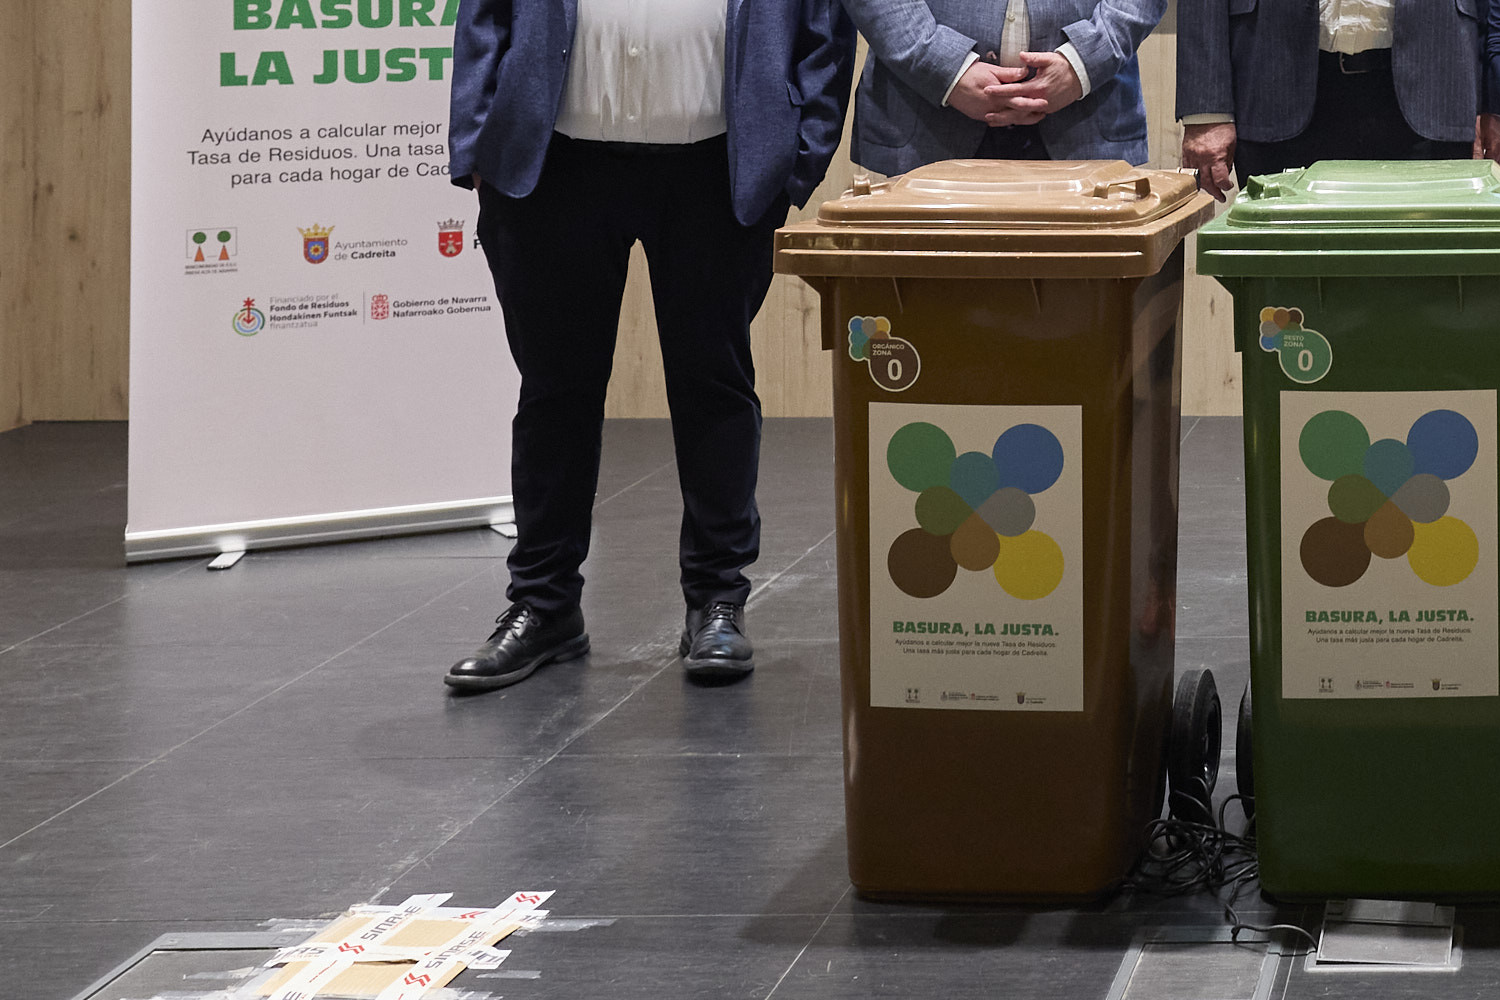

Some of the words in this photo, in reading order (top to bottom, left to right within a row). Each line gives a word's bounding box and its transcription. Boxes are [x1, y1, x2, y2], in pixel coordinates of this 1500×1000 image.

[220, 51, 294, 86] LA
[313, 47, 453, 84] JUST
[201, 127, 293, 146] Ayúdanos
[299, 127, 311, 139] a
[317, 123, 387, 139] calcular
[393, 120, 443, 138] mejor
[187, 150, 231, 165] Tasa
[238, 149, 261, 163] de
[269, 146, 358, 162] Residuos.
[366, 144, 401, 158] Una
[408, 142, 445, 156] tasa
[231, 170, 272, 189] para
[278, 166, 323, 183] cada
[330, 165, 382, 184] hogar
[387, 162, 409, 179] de
[334, 237, 408, 251] Ayuntamiento
[334, 251, 348, 261] de
[350, 250, 396, 260] Cadreita
[270, 304, 297, 312] Fondo
[298, 302, 309, 310] de
[311, 300, 350, 310] Residuos
[392, 299, 435, 308] Gobierno
[452, 296, 487, 304] Navarra
[270, 312, 322, 322] Hondakinen
[324, 309, 358, 318] Funtsak
[392, 308, 444, 318] Nafarroako
[446, 305, 491, 314] Gobernua
[1283, 334, 1304, 342] RESTO
[872, 342, 905, 350] ORGÁNICO
[1298, 350, 1313, 372] 0
[888, 358, 902, 380] 0
[1305, 610, 1383, 625] BASURA,
[1389, 610, 1411, 623] LA
[1415, 610, 1474, 622] JUSTA.
[893, 621, 969, 637] BASURA,
[974, 623, 996, 635] LA
[1000, 623, 1059, 636] JUSTA.
